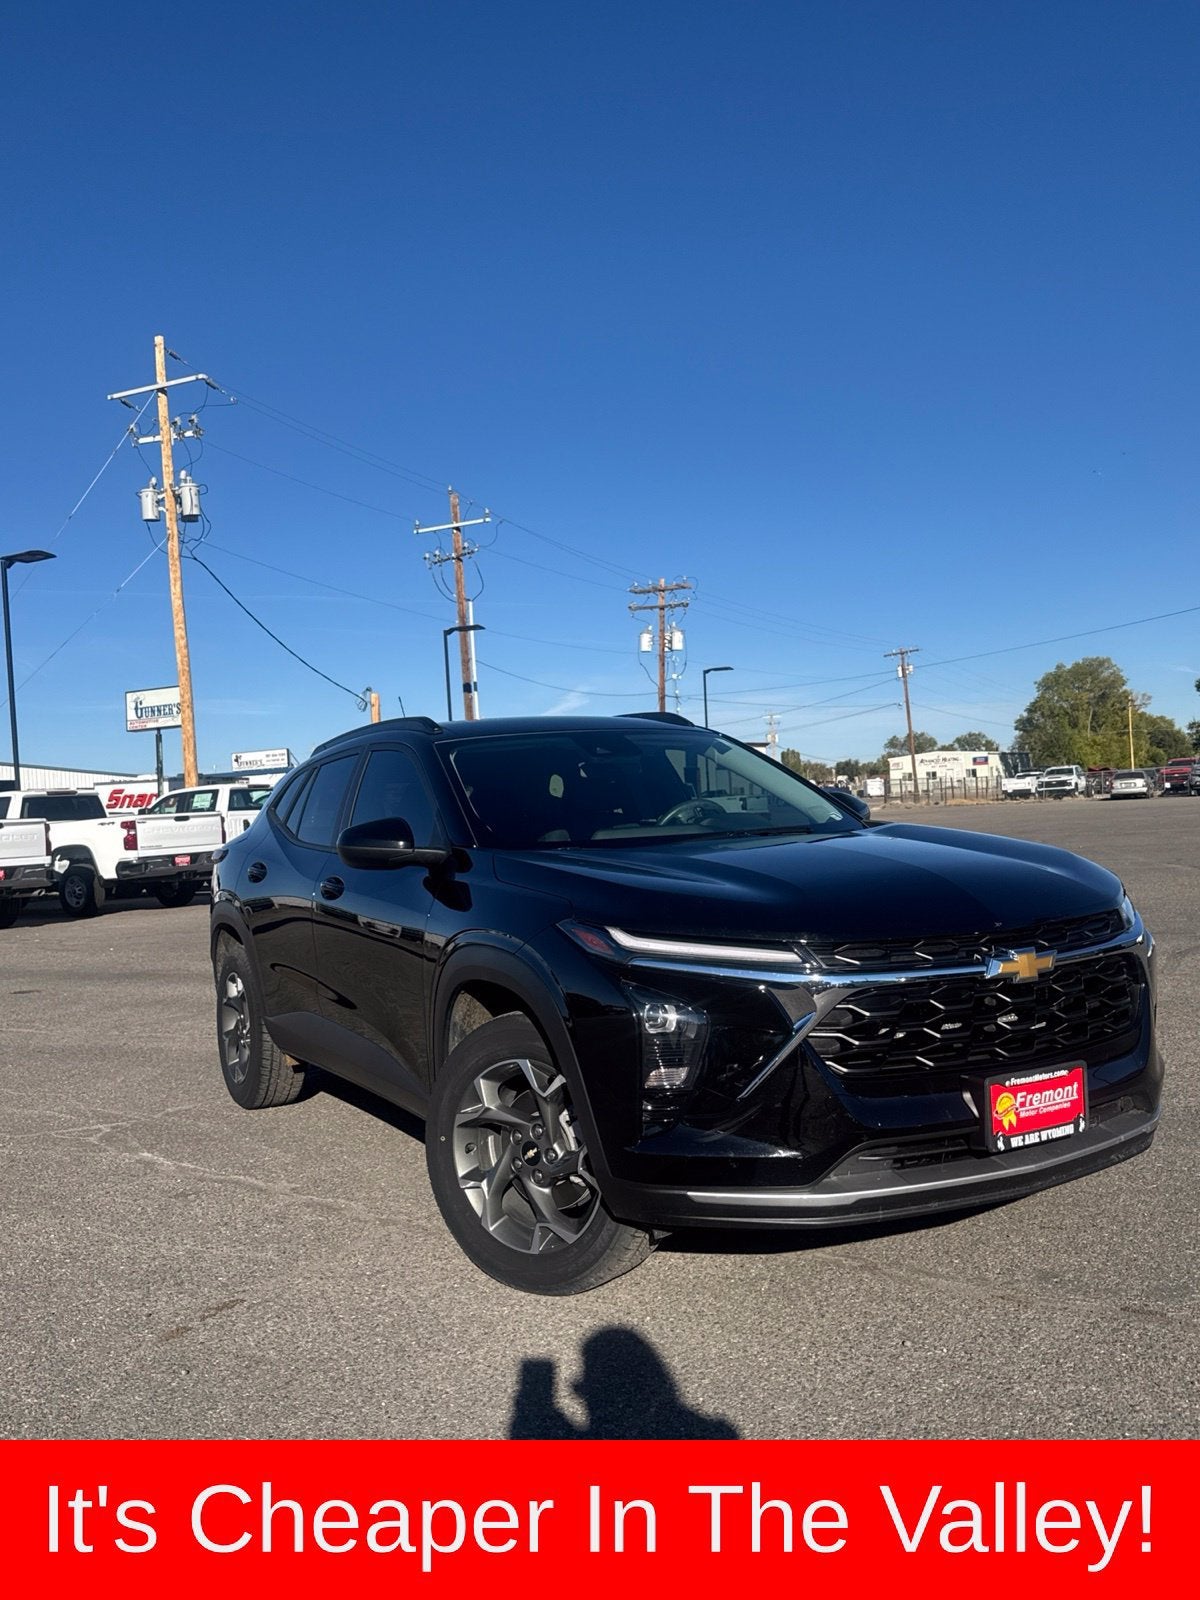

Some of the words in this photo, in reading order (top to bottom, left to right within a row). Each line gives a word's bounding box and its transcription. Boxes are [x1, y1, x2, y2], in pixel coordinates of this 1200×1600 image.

[1016, 1082, 1078, 1108] Fremont
[1019, 1109, 1038, 1118] Motor
[1039, 1102, 1071, 1115] Companies
[1010, 1135, 1024, 1148] WE
[1024, 1131, 1040, 1145] ARE
[1040, 1124, 1075, 1141] WYOMING
